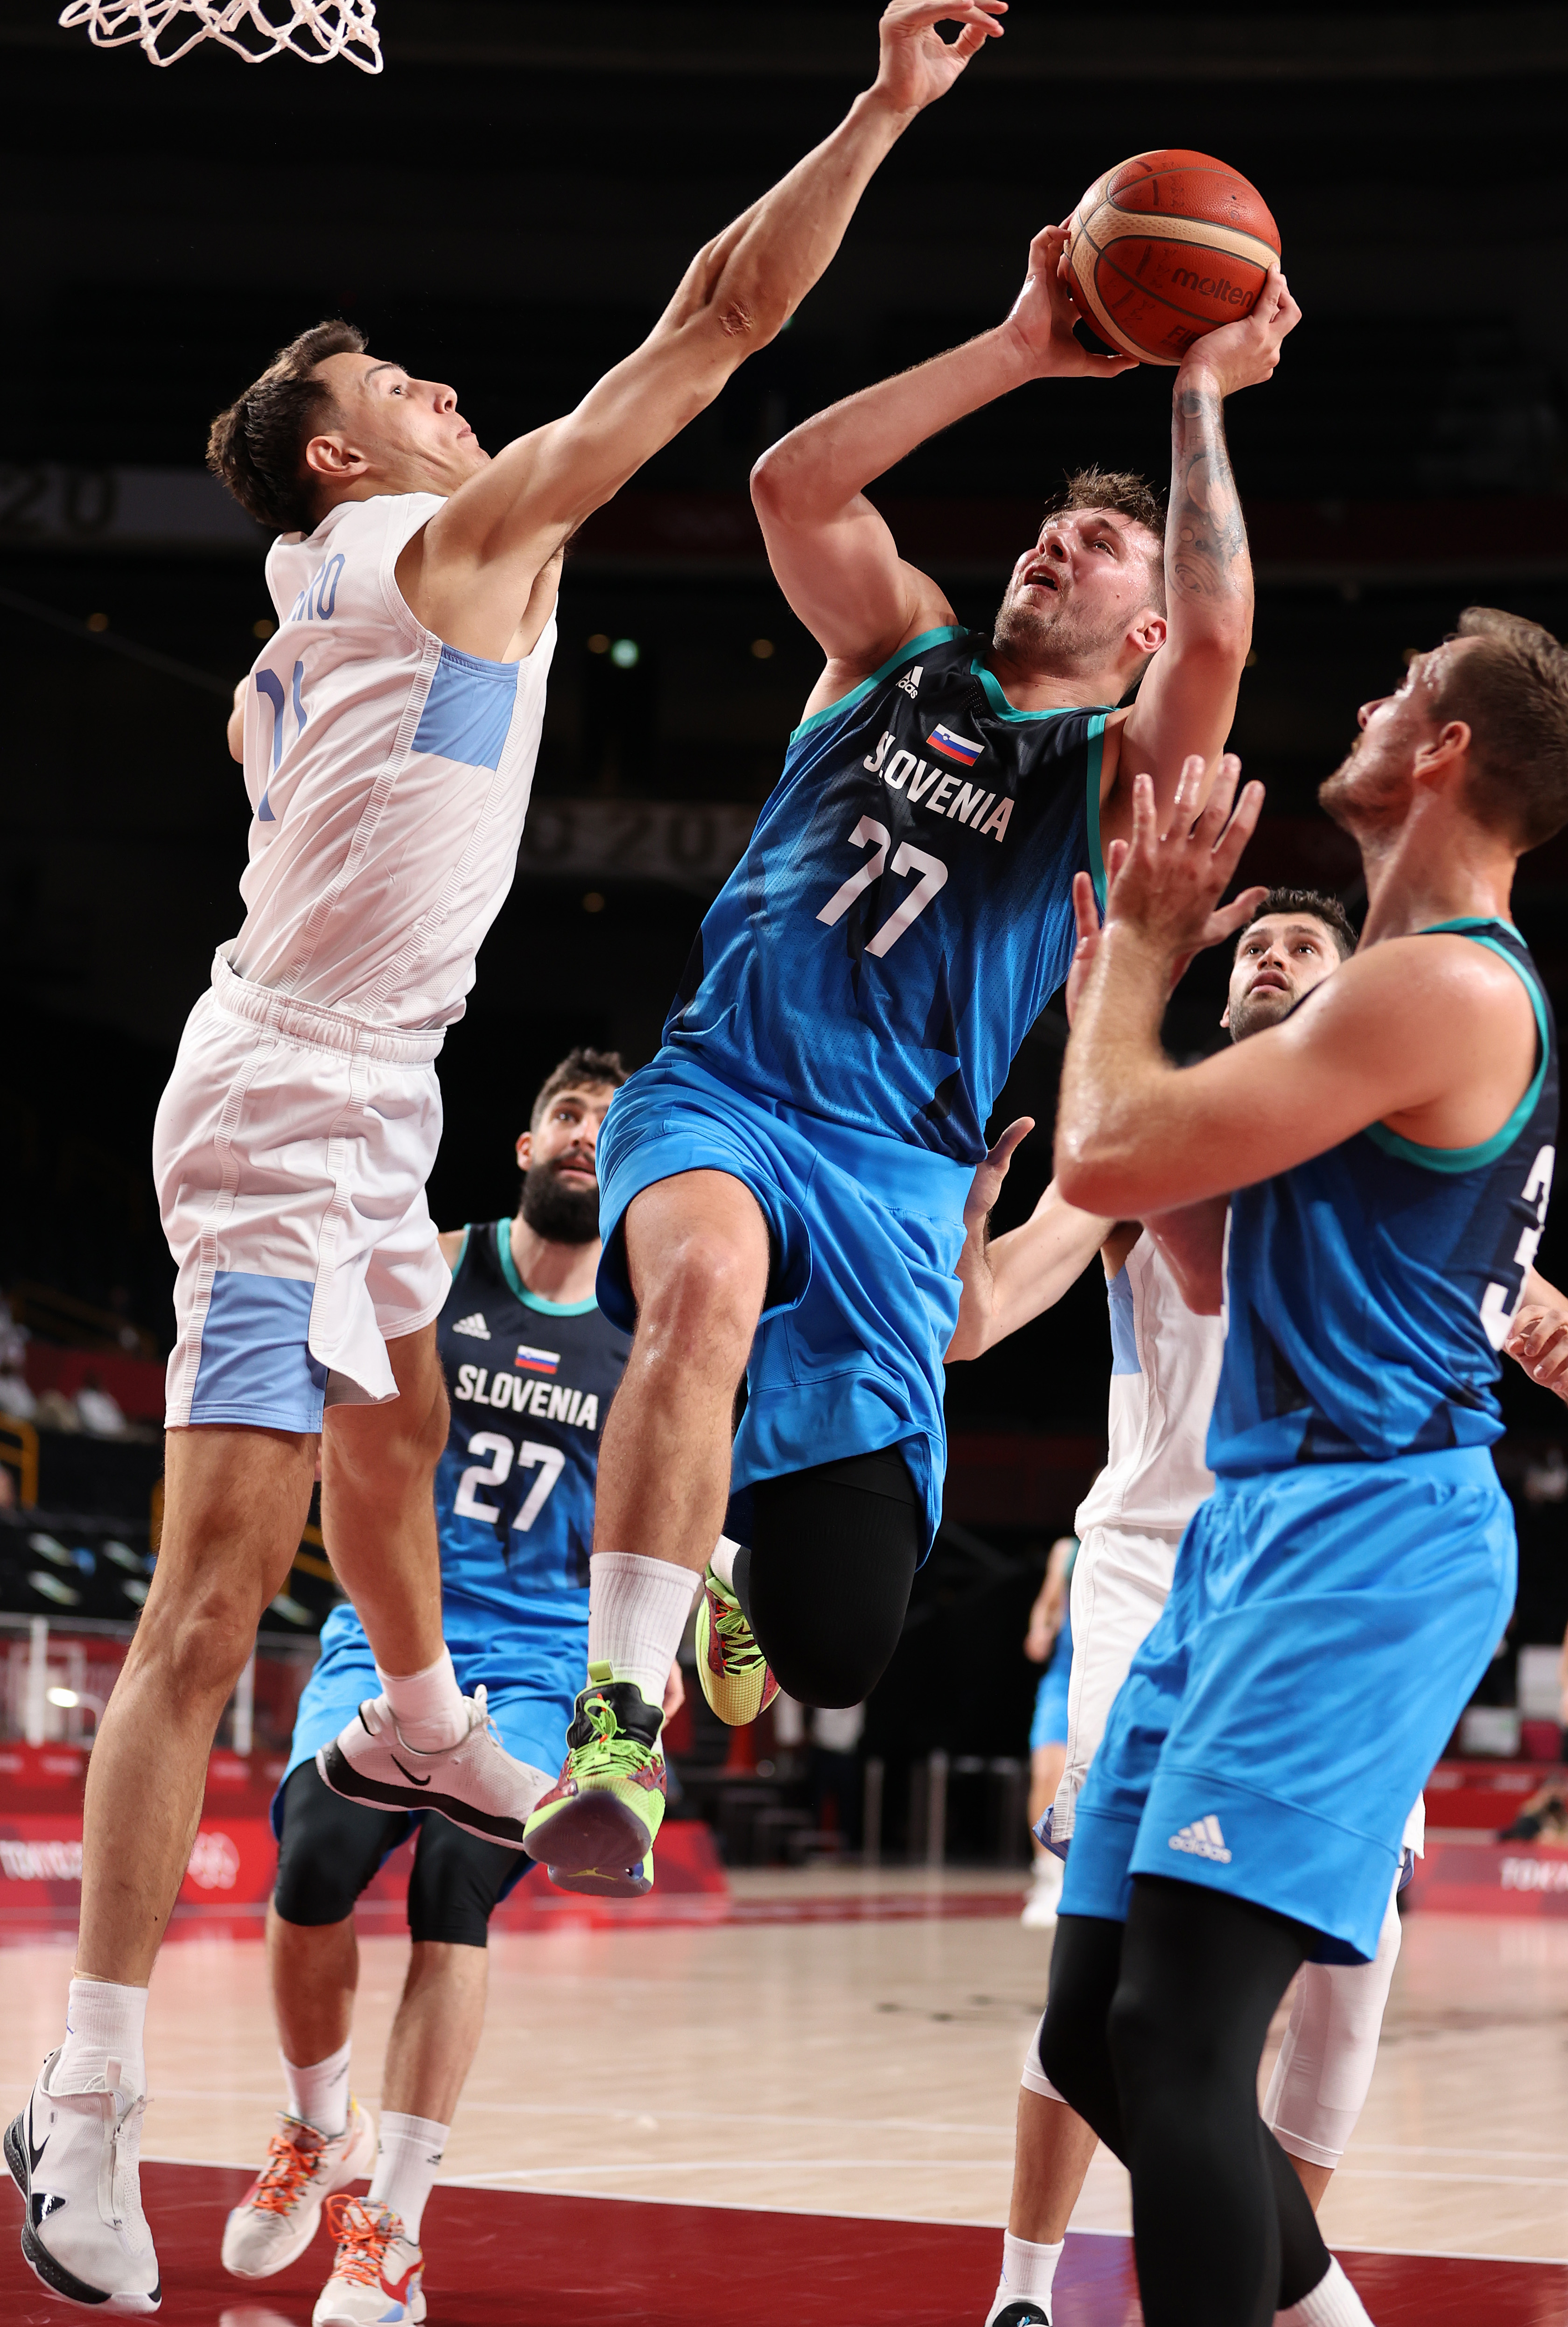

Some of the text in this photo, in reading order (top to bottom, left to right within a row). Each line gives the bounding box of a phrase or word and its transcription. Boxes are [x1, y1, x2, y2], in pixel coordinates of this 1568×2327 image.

[1171, 267, 1254, 308] molten
[862, 730, 1015, 843] SLOVENIA
[815, 814, 948, 958] 77
[454, 1364, 599, 1431] SLOVENIA
[453, 1430, 566, 1533] 27
